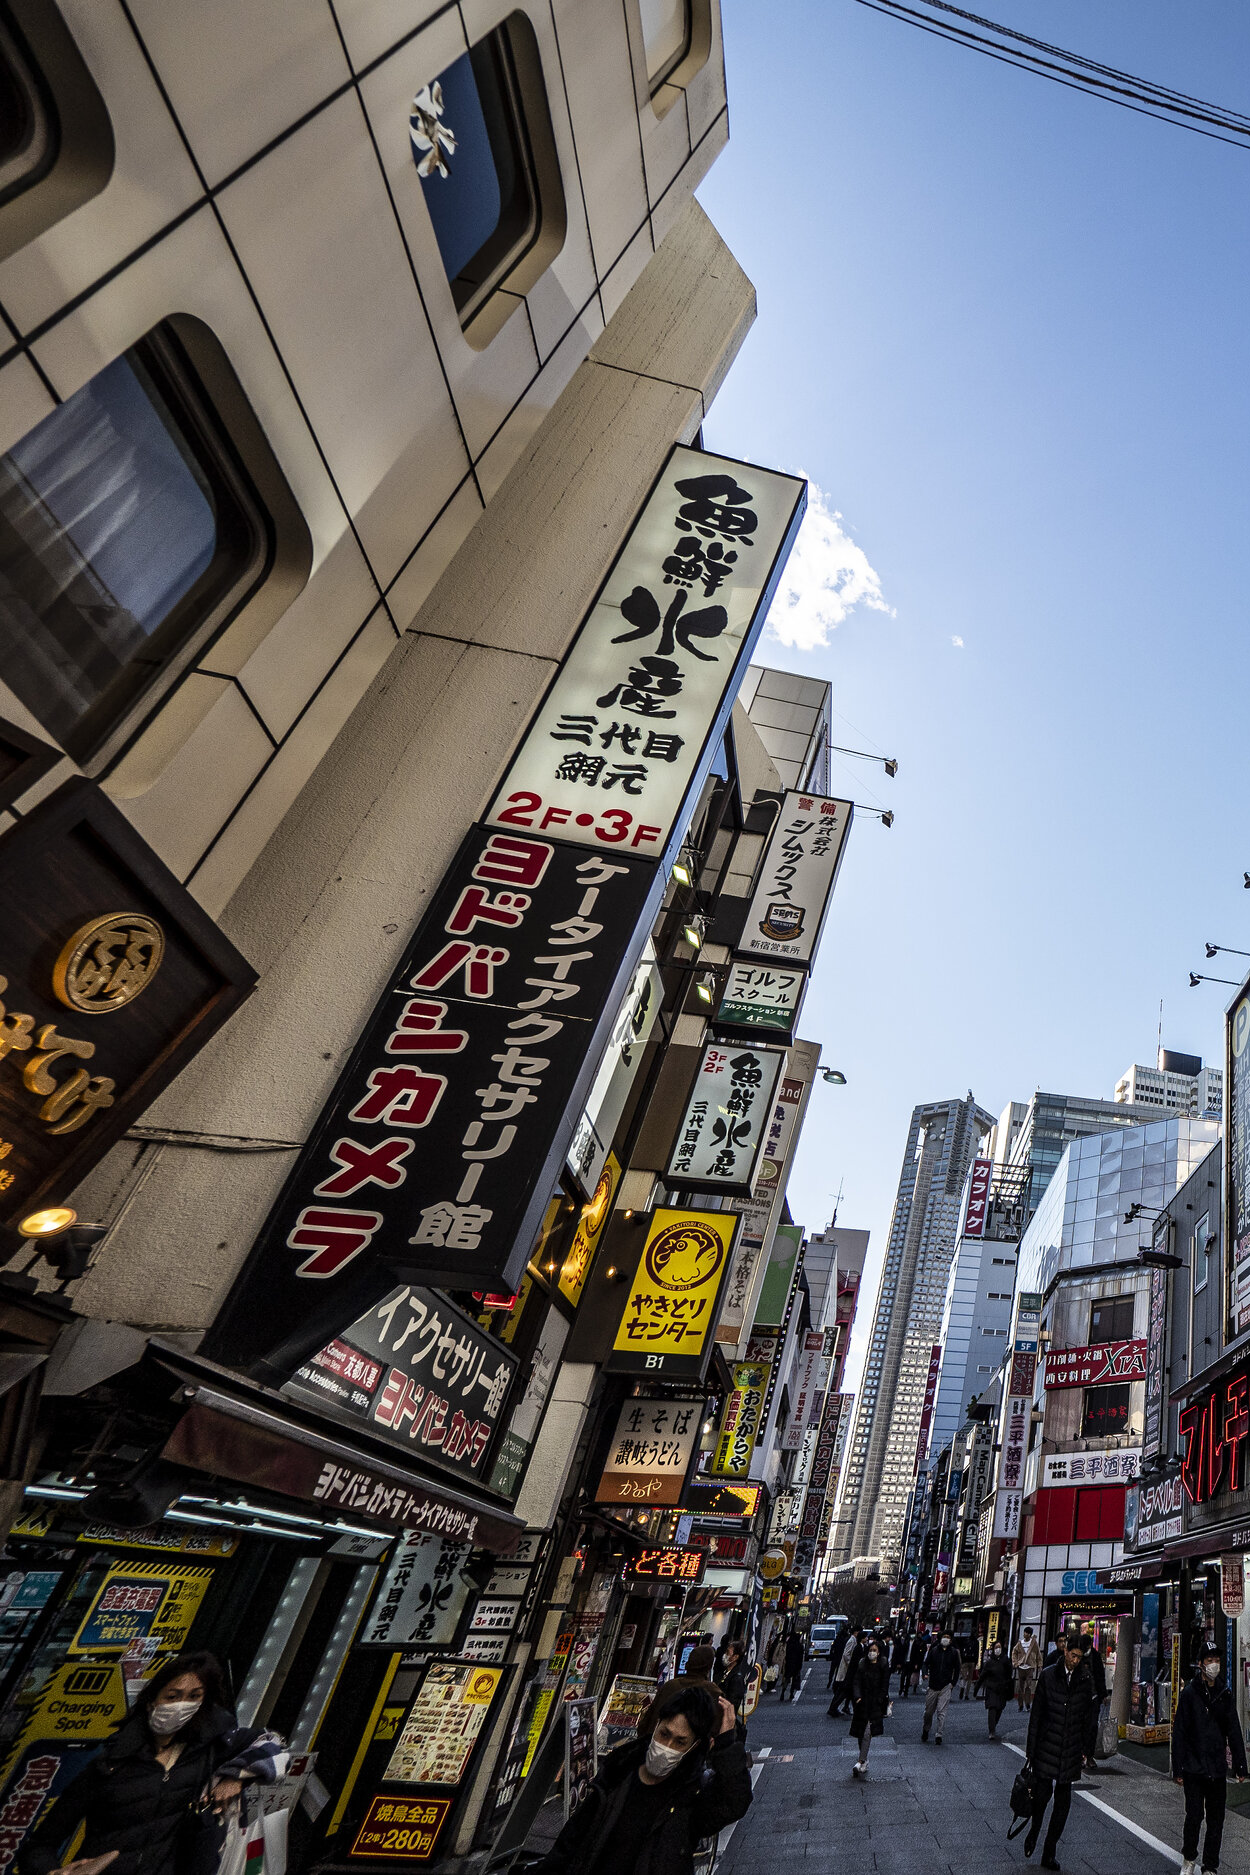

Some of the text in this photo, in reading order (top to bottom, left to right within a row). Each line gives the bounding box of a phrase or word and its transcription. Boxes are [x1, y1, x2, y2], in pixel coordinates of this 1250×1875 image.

[598, 473, 759, 720] 魚鮮水産
[551, 715, 686, 763] 三代目
[554, 752, 650, 796] 網元
[797, 797, 837, 816] 警備
[809, 816, 839, 857] 株式会社
[766, 818, 816, 901] シムックス
[750, 939, 801, 956] 新宿営業所
[731, 986, 791, 1005] スクール
[735, 969, 797, 990] ゴルフ
[286, 834, 557, 1279] ヨドバシカメラ
[408, 856, 631, 1250] ケータイアクセサリー館
[703, 1062, 725, 1074] 2F
[707, 1051, 728, 1063] 3F
[706, 1052, 764, 1178] 魚鮮水産
[673, 1100, 709, 1174] 三代目網元
[966, 1165, 990, 1229] カラオケ
[727, 1251, 755, 1309] 本格そば
[630, 1293, 708, 1321] やきとり
[377, 1285, 511, 1419] イアクセサリー館
[626, 1319, 704, 1344] センター
[645, 1354, 664, 1370] B1
[1045, 1368, 1093, 1385] 西安料理
[923, 1358, 940, 1412] カラオケ
[374, 1367, 492, 1469] ヨドバシカメラ
[624, 1407, 695, 1436] 生そば
[723, 1390, 743, 1432] 高価買取
[729, 1389, 761, 1472] おたからや
[614, 1439, 683, 1467] 讃岐うどん
[813, 1393, 842, 1487] ヨドバシカメラ
[313, 1462, 479, 1541] ヨドバシカメラ ケータイアクセサリー館
[801, 1494, 824, 1538] 時計館
[973, 1475, 987, 1519] Camera
[1138, 1475, 1183, 1524] トラベル館
[406, 1531, 433, 1547] 2F
[965, 1523, 979, 1557] GMT
[98, 1584, 164, 1612] 急速充電器
[370, 1551, 418, 1641] 三代目網元
[1060, 1571, 1115, 1595] SEG
[92, 1613, 139, 1628] スマートフォン
[47, 1700, 115, 1716] Charging
[54, 1717, 92, 1733] Spot
[374, 1803, 439, 1825] 焼鳥全品
